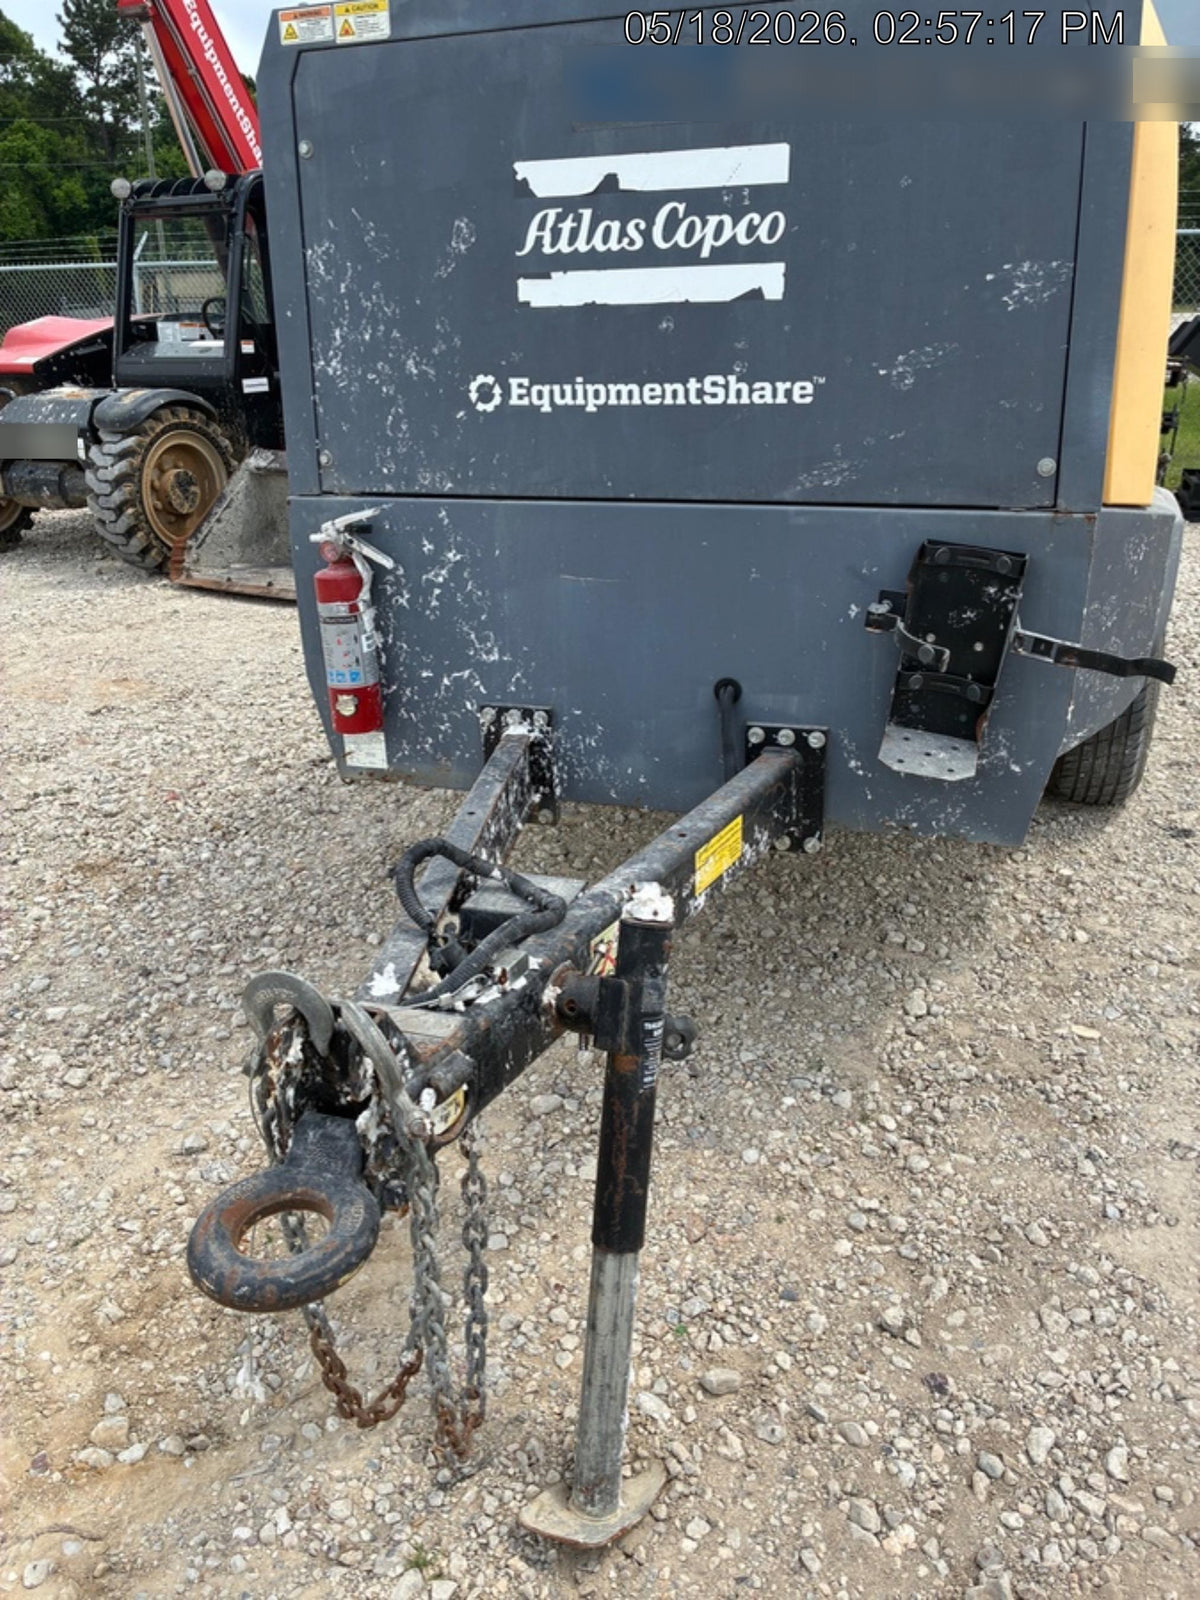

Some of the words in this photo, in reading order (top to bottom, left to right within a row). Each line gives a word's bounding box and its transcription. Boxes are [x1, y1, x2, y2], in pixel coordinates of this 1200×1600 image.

[351, 3, 380, 12] CAUTION
[515, 207, 646, 257] Atlas
[651, 201, 787, 258] Copco
